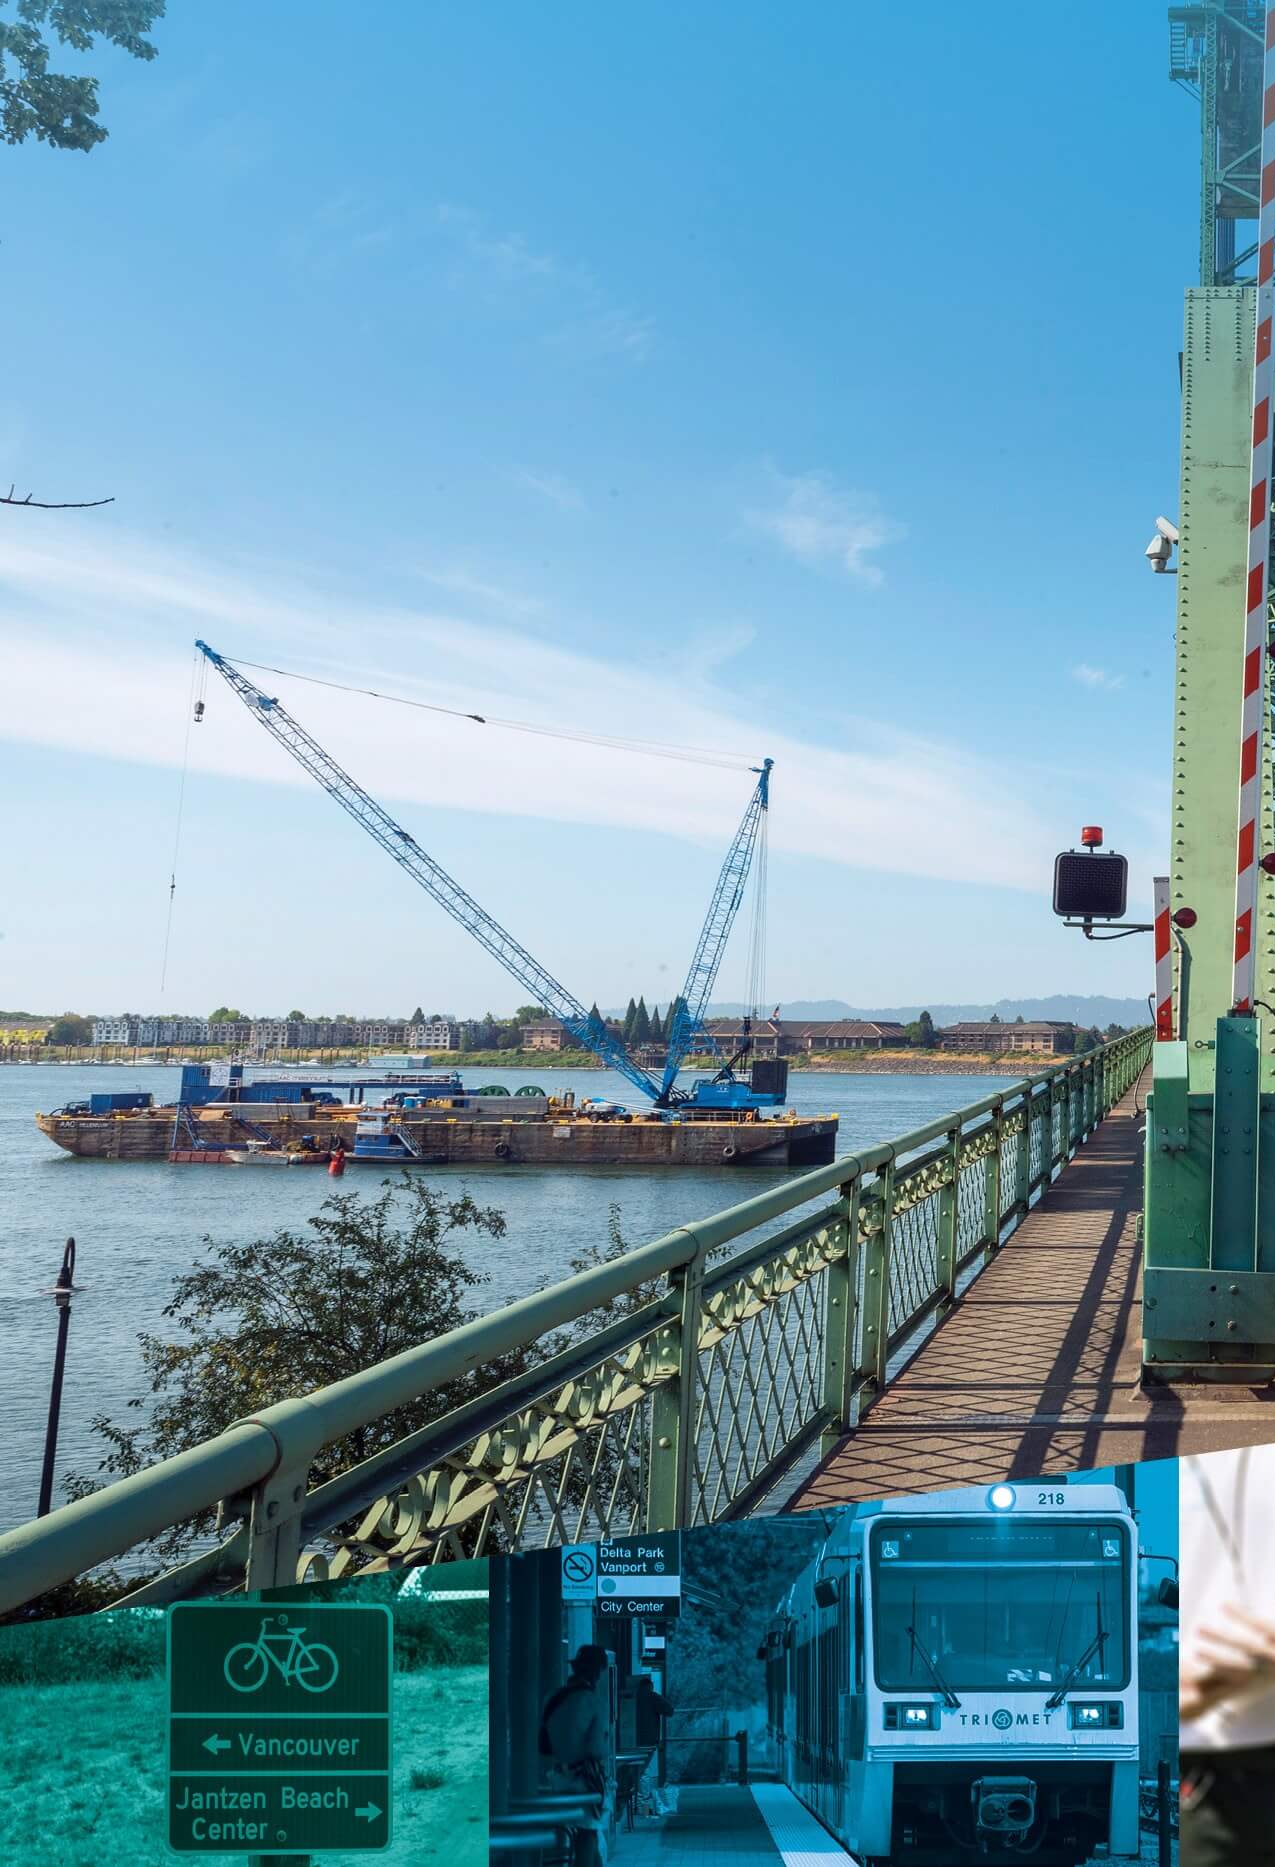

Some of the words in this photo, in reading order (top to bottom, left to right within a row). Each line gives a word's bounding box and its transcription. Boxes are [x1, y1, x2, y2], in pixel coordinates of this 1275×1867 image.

[1038, 1494, 1064, 1505] 218
[600, 1548, 631, 1558] Delta
[638, 1548, 664, 1558] Park
[601, 1562, 647, 1574] Vanport
[601, 1601, 622, 1613] City
[627, 1601, 664, 1611] Center
[238, 1733, 360, 1757] Vancouver
[175, 1787, 267, 1811] Jantzen
[280, 1787, 349, 1810] Beach
[191, 1817, 269, 1841] Center
